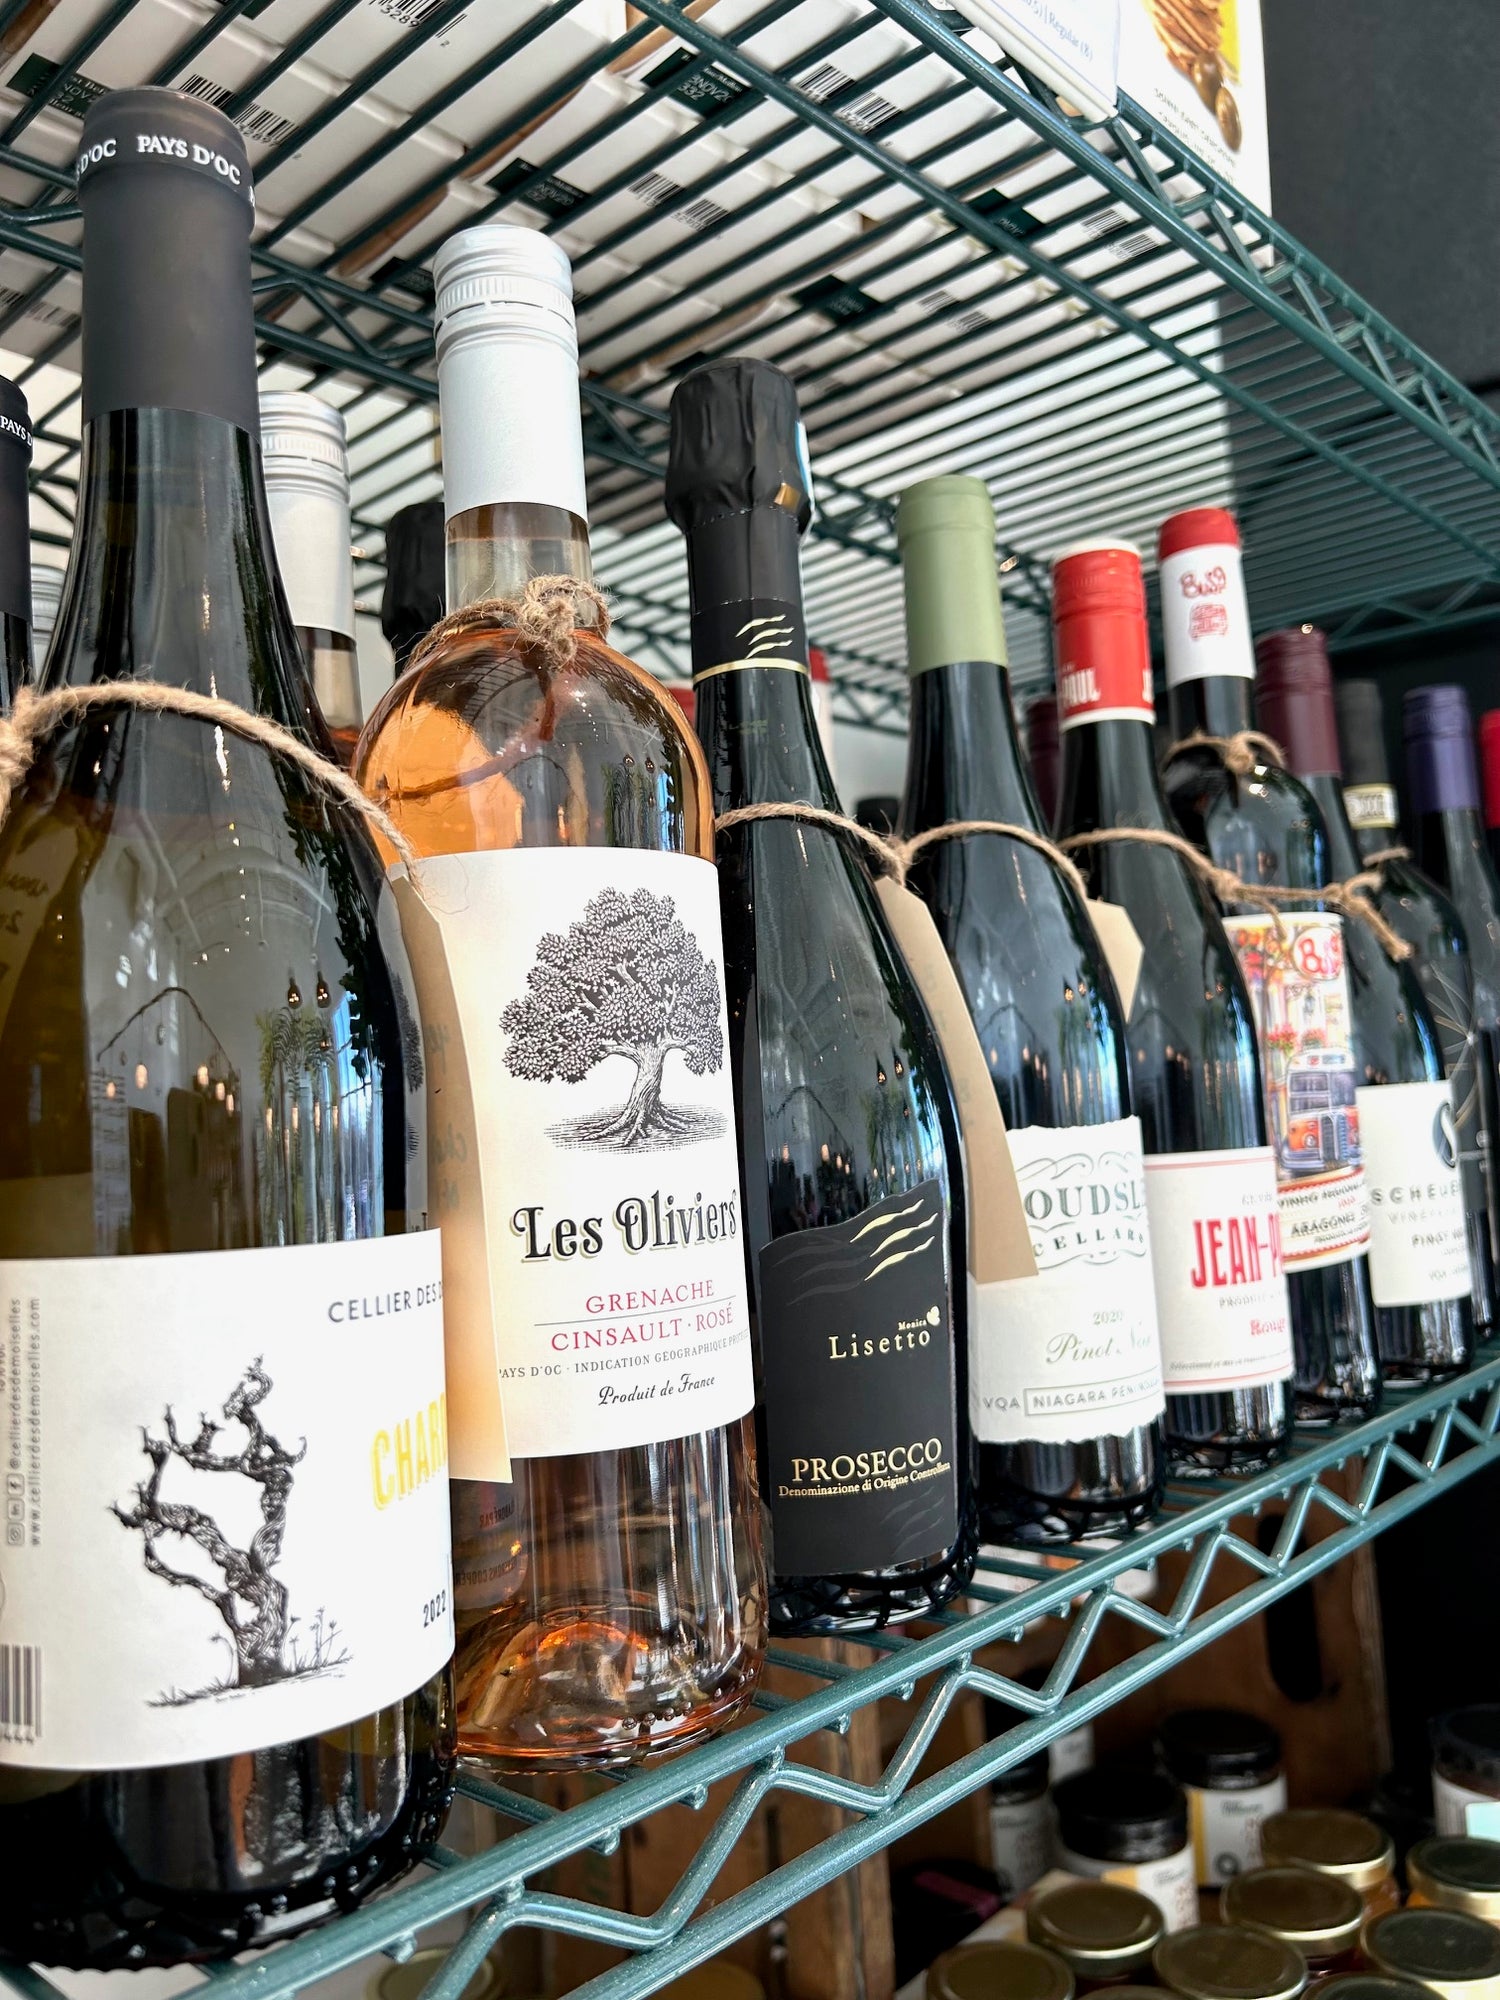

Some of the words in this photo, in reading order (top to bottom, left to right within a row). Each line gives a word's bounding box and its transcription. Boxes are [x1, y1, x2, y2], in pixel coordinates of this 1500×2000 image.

[80, 139, 117, 174] D'OC
[136, 134, 189, 159] PAYS
[192, 144, 242, 186] D'OC
[0, 415, 27, 440] PAYS
[1023, 1181, 1146, 1220] OUDSL
[511, 1206, 604, 1261] Les
[614, 1189, 738, 1251] Oliviers
[328, 1290, 411, 1323] CELLIER
[417, 1283, 437, 1308] DES
[585, 1279, 715, 1314] GRENACHE
[551, 1318, 683, 1352] CINSAULT
[696, 1302, 733, 1332] ROSÉ
[898, 1319, 928, 1331] Monica
[828, 1329, 931, 1359] Lisetto
[1046, 1333, 1114, 1365] Pinot
[531, 1364, 562, 1377] D'OC
[575, 1354, 651, 1374] INDICATION
[598, 1385, 656, 1406] Produit
[660, 1379, 674, 1397] de
[677, 1373, 715, 1393] France
[984, 1397, 1021, 1412] VQA
[1033, 1393, 1105, 1409] NIAGARA
[791, 1437, 943, 1483] PROSECCO
[778, 1483, 860, 1498] Denominazione
[862, 1479, 872, 1491] di
[874, 1474, 909, 1491] Origine
[423, 1589, 446, 1628] 2022
